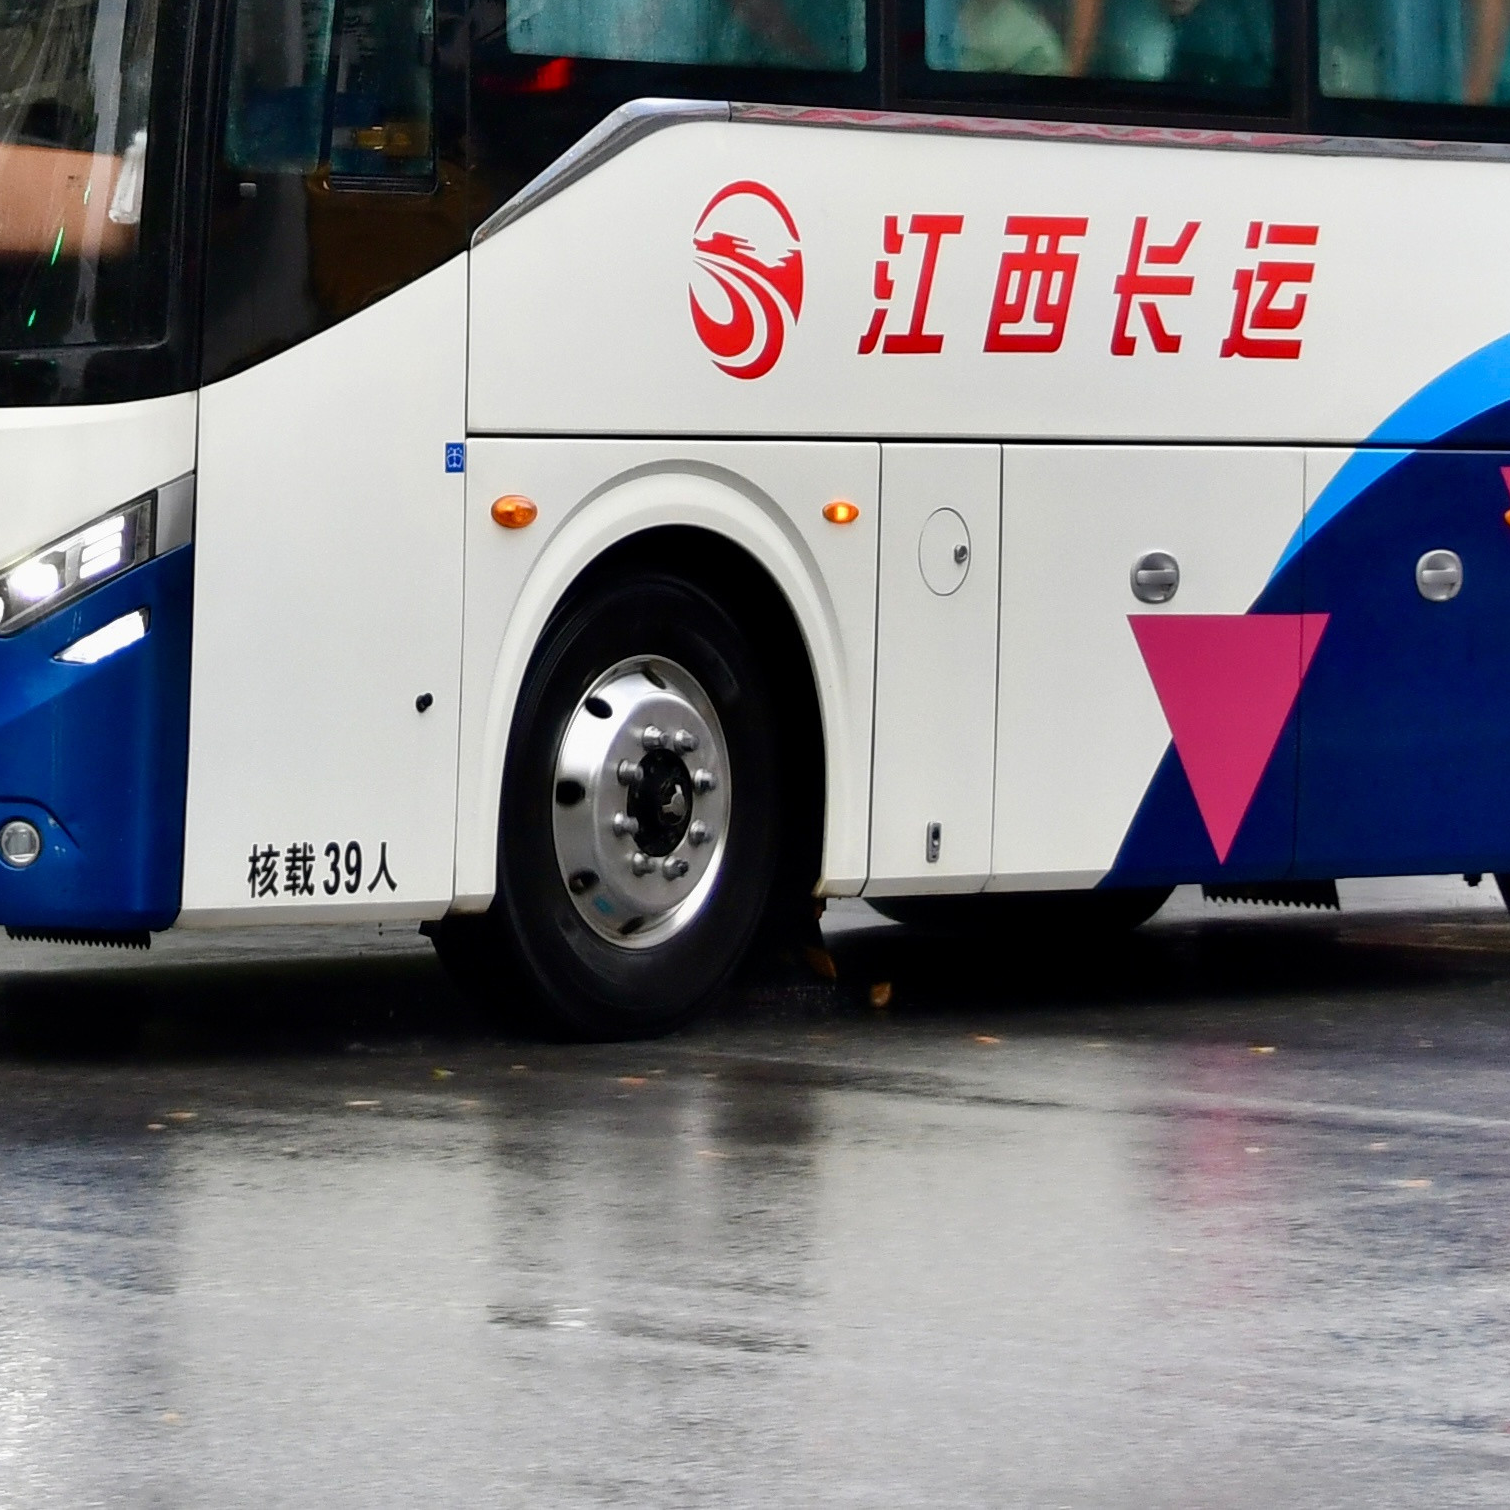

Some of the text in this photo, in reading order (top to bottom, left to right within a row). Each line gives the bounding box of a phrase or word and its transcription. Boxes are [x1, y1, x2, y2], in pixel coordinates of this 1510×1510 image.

[856, 214, 1321, 359] 江西长运
[247, 840, 398, 899] 核载39人
